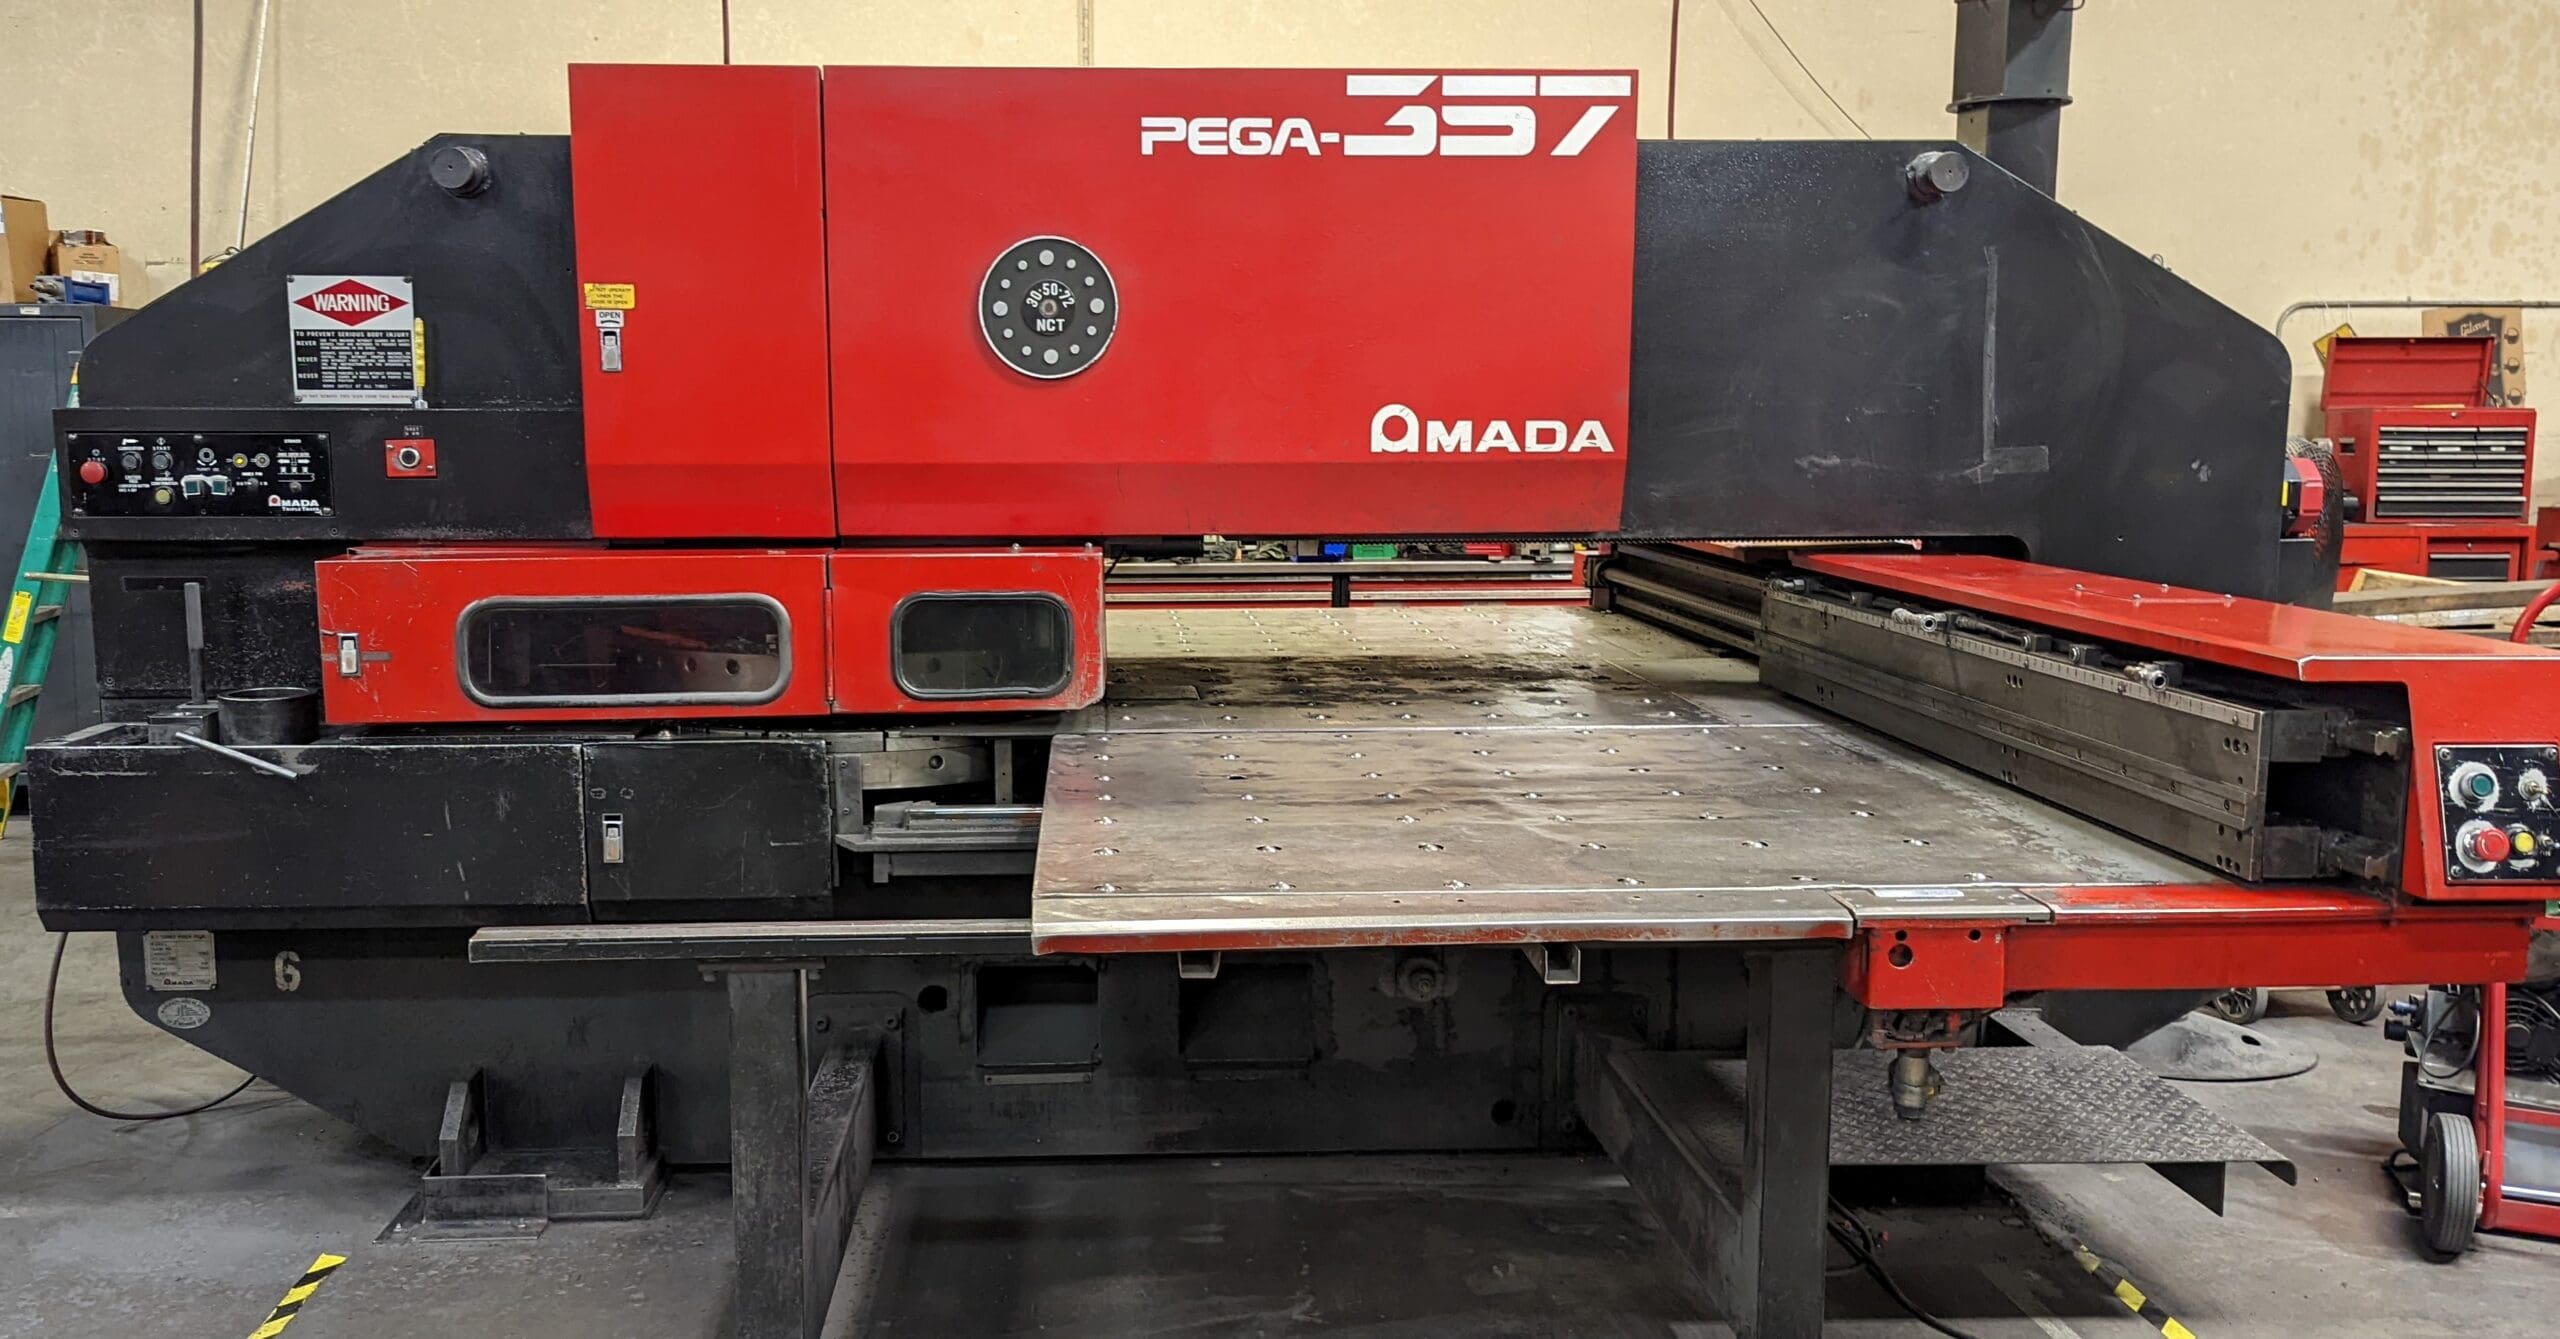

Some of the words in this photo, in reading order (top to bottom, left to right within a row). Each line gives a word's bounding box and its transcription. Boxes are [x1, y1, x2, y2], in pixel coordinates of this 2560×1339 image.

[312, 293, 390, 312] WARNING
[1036, 318, 1066, 332] NCT
[1370, 403, 1615, 453] AMADA
[268, 494, 320, 507] AMADA
[275, 950, 301, 992] 6
